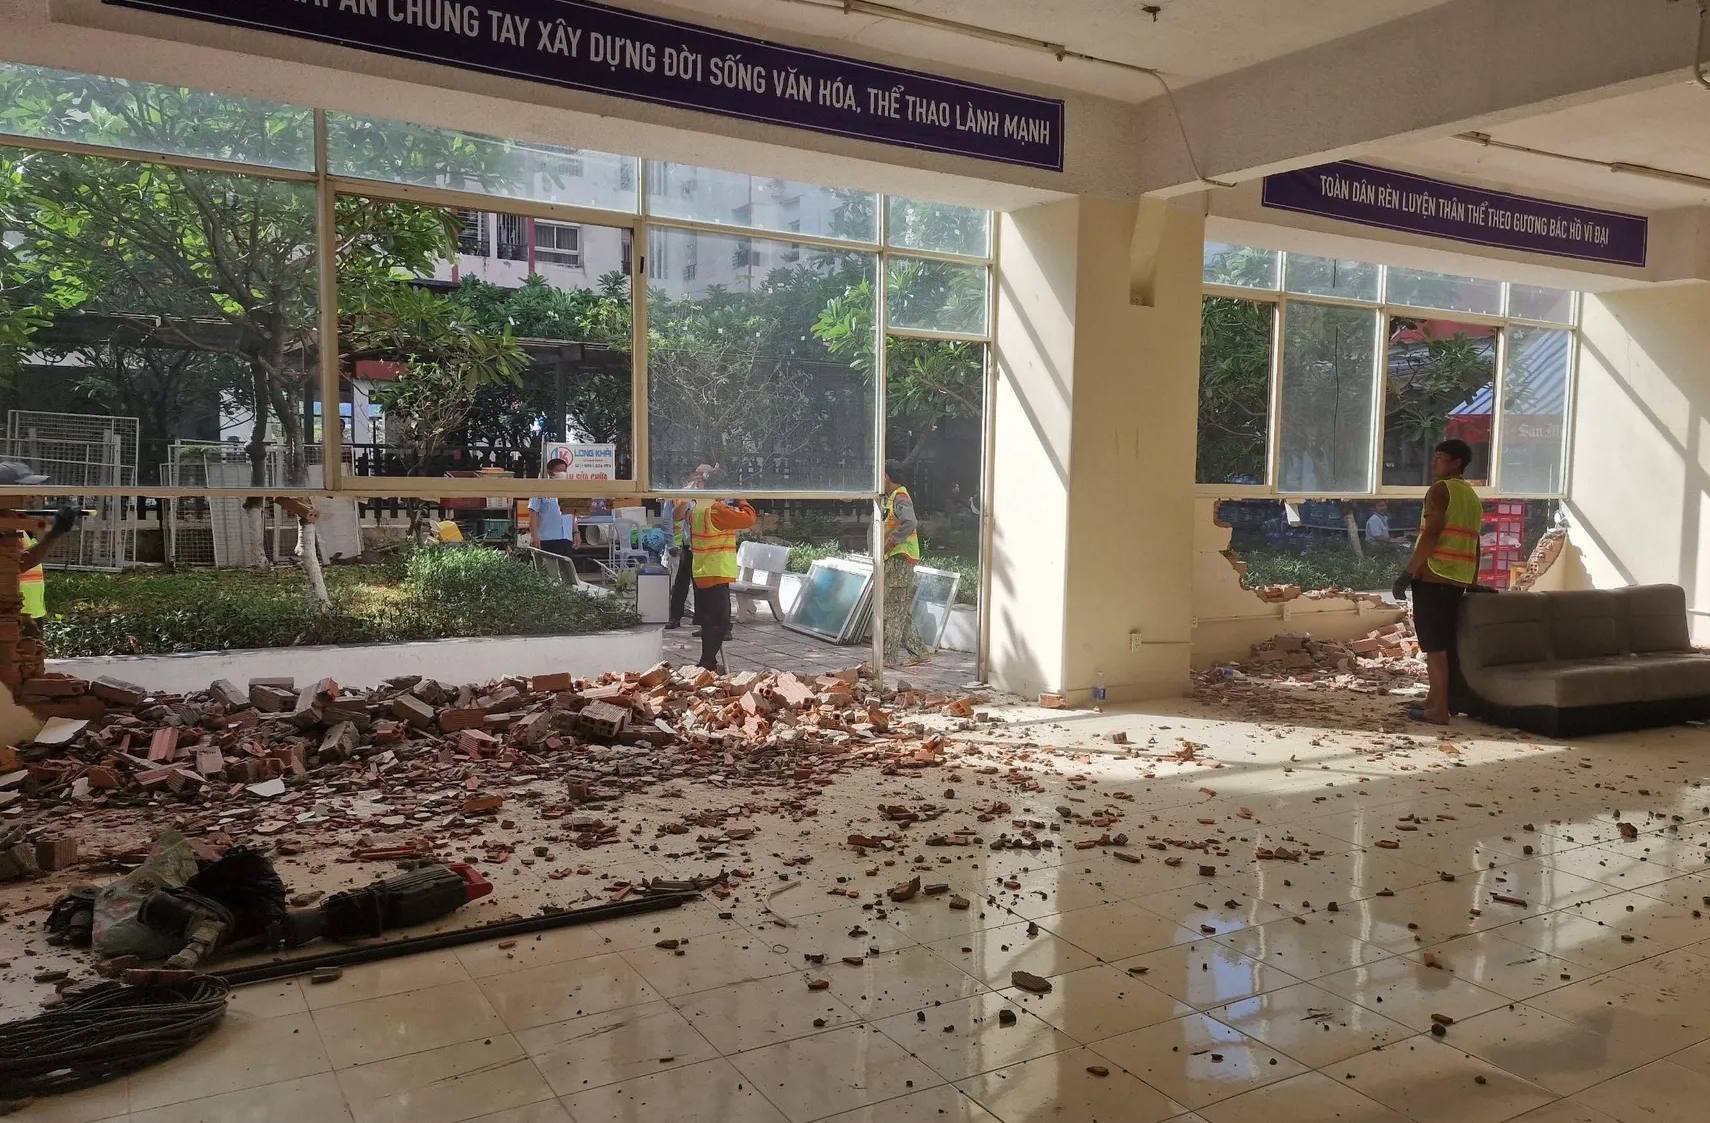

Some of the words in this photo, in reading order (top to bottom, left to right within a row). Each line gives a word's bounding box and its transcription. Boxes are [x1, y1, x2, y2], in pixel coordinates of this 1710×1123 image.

[388, 0, 480, 38] CHUNG
[488, 10, 530, 47] TAY
[537, 18, 582, 58] XÂY
[590, 31, 656, 72] DỰNG
[663, 44, 702, 82] ĐỜI
[709, 54, 766, 94] SỐNG
[773, 66, 812, 102] VĂN
[818, 77, 861, 113] HÓA,
[867, 85, 905, 119] THỂ
[905, 95, 950, 128] THAO
[956, 102, 999, 136] LÀNH
[1004, 113, 1050, 145] MẠNH
[1320, 173, 1349, 200] TOÀN
[1352, 179, 1376, 205] DÂN
[1377, 184, 1400, 210] RÈN
[1402, 191, 1436, 219] LUYỆN
[1439, 198, 1465, 222] THÂN
[1467, 201, 1489, 226] THỂ
[1488, 208, 1511, 230] THEO
[1513, 213, 1547, 236] GƯƠNG
[1550, 216, 1567, 239] BÁC
[1569, 217, 1582, 241] HỒ
[1584, 221, 1595, 242] VĨ
[1594, 226, 1609, 248] ĐẠI
